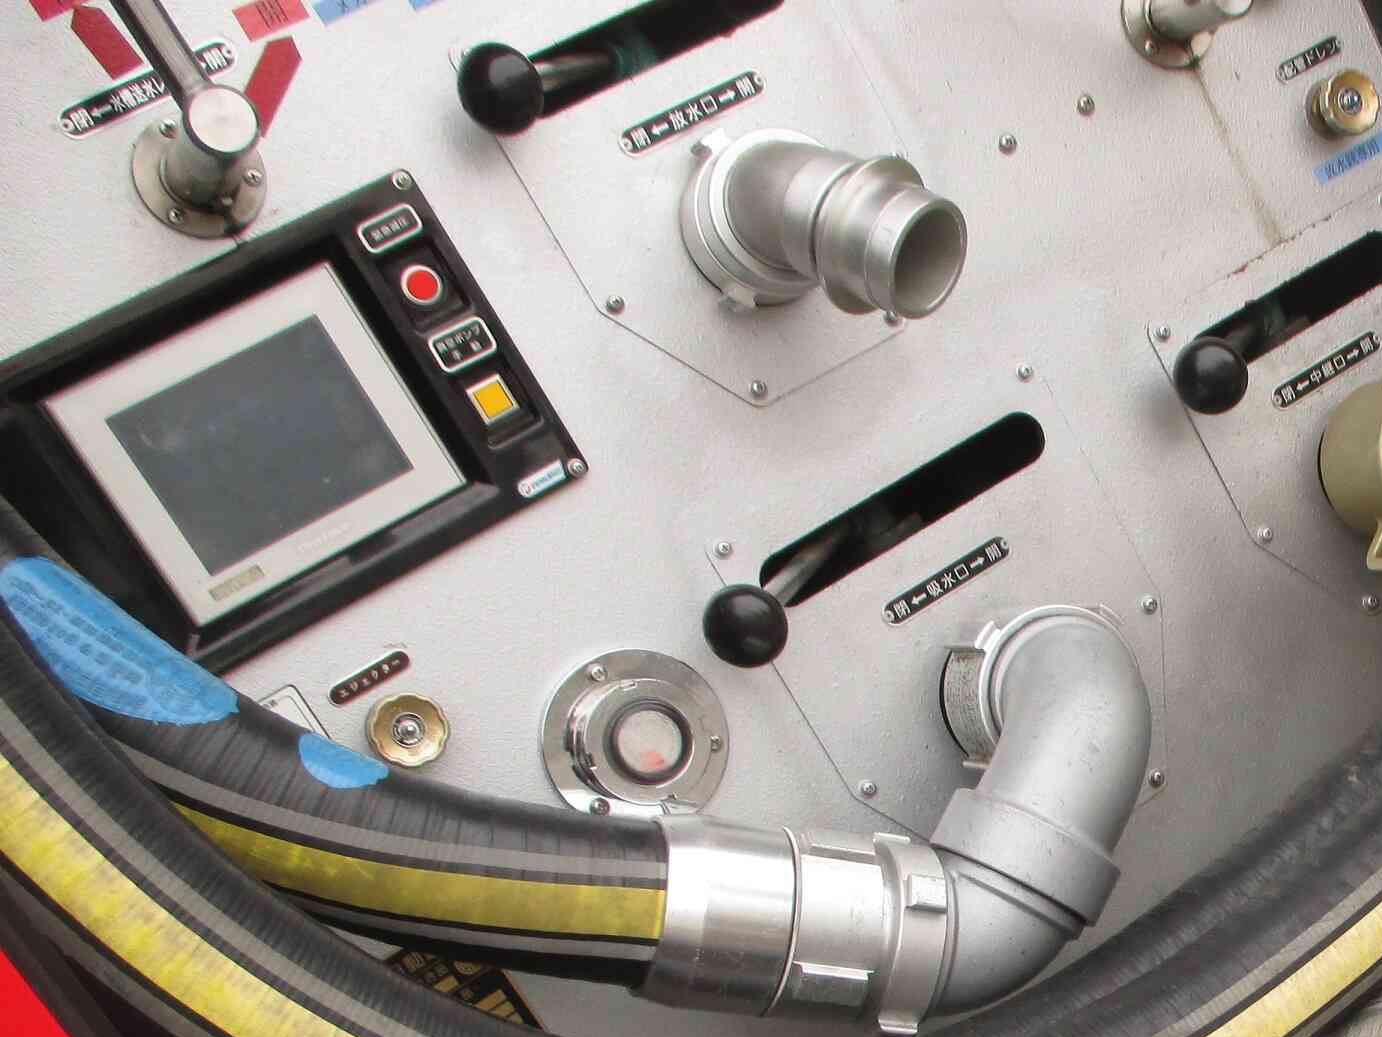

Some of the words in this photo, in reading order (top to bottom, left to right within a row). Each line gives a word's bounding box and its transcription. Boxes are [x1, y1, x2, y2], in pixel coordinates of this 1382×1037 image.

[669, 95, 718, 131] 放水口
[1281, 386, 1296, 405] 閉
[893, 600, 912, 619] 閉
[926, 561, 970, 600] 吸水口
[984, 542, 1003, 562] 開
